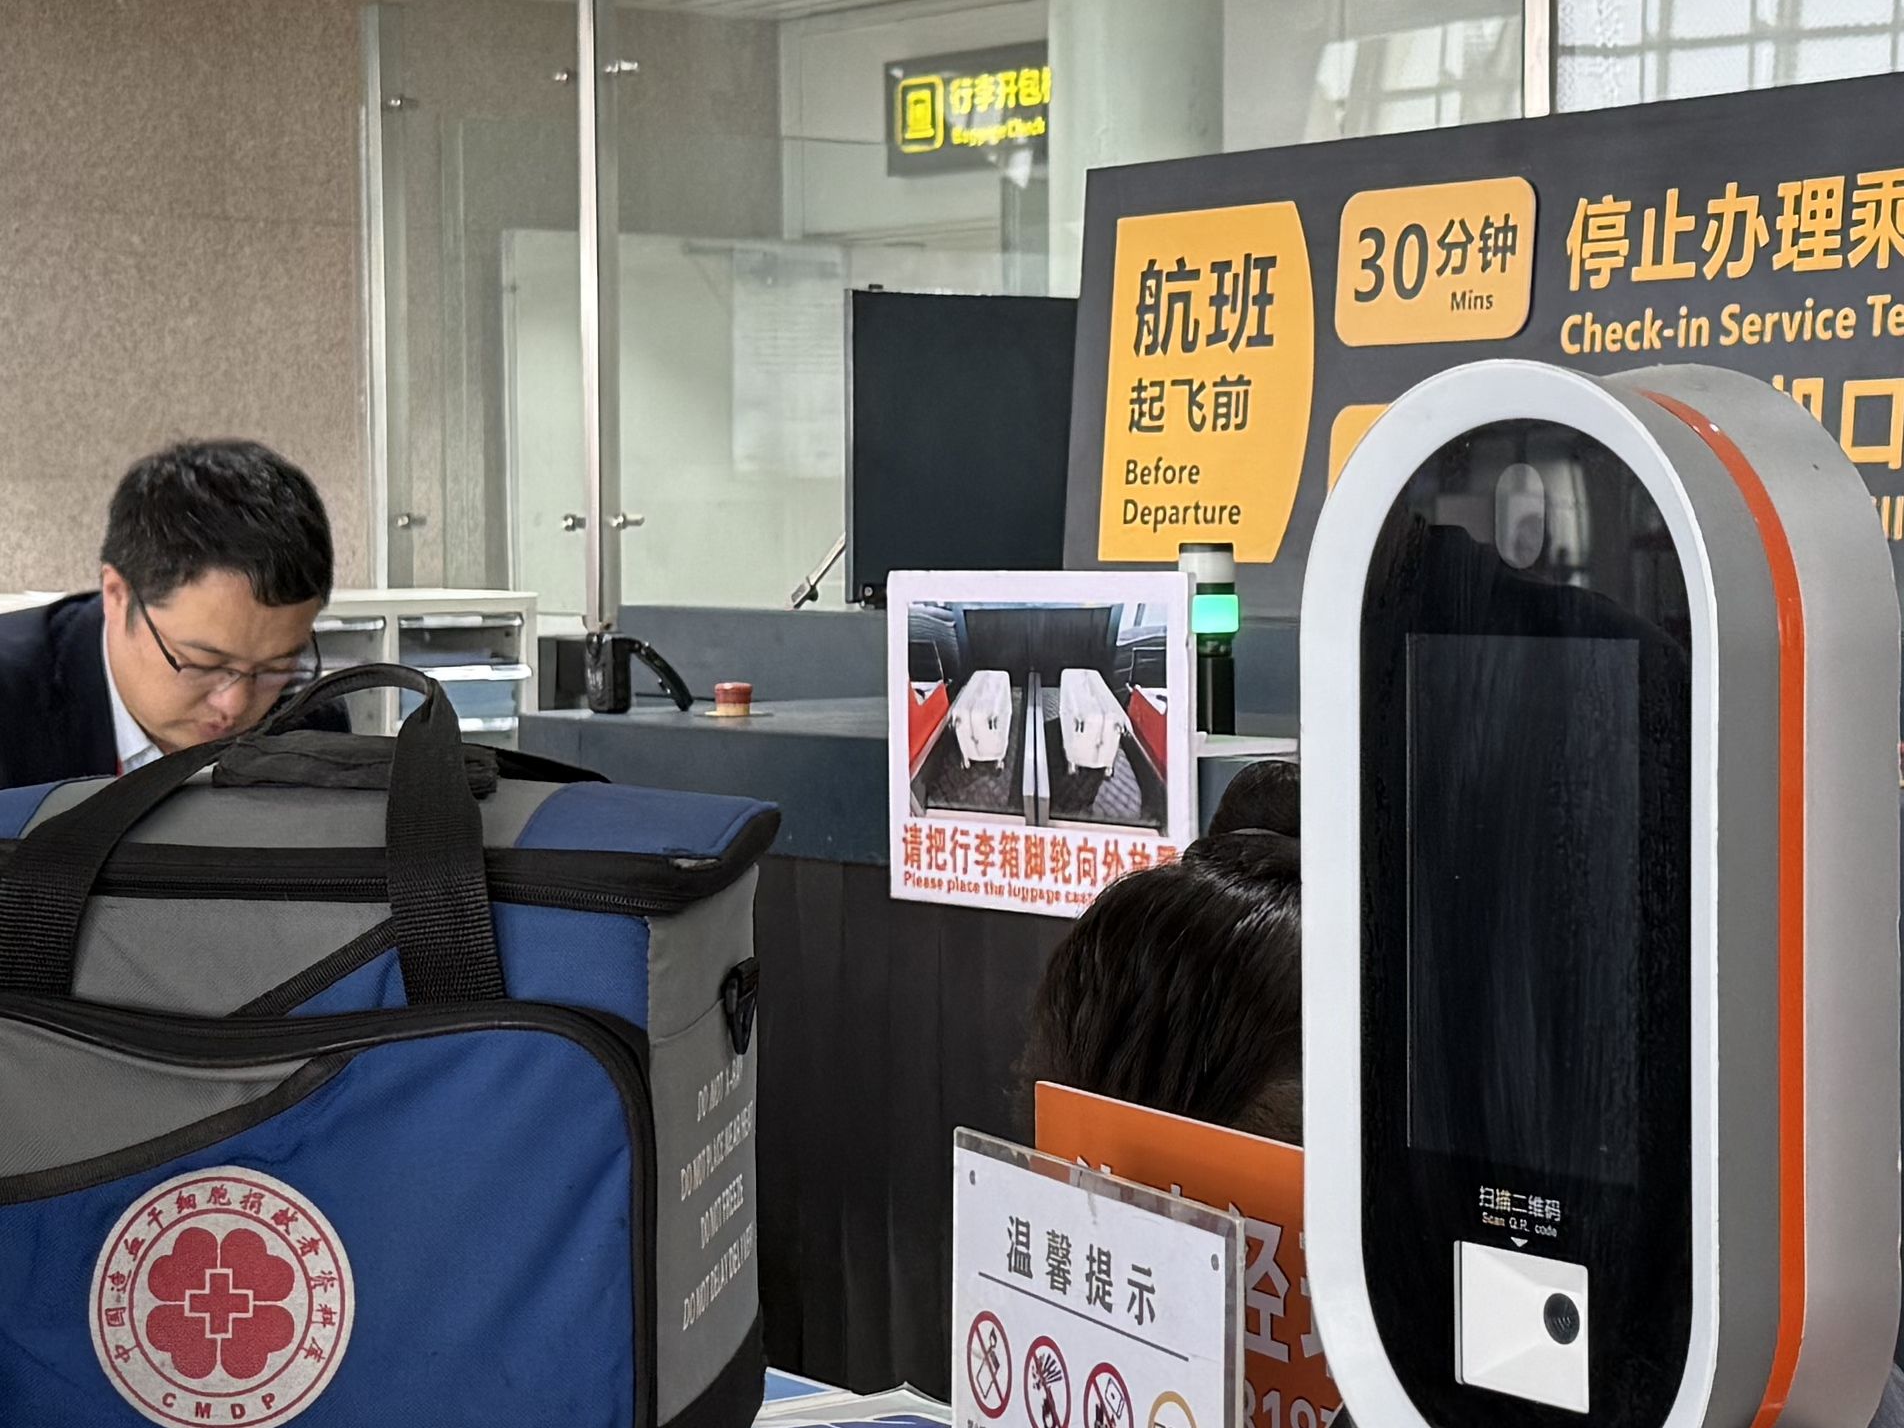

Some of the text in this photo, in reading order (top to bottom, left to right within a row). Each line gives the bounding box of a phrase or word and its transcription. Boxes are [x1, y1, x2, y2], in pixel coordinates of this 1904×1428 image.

[1354, 213, 1518, 303] 30分钟
[1133, 253, 1277, 357] 航班
[1450, 289, 1494, 313] Mins
[1560, 306, 1710, 354] Check-in
[1720, 297, 1857, 347] Service
[1128, 375, 1252, 434] 起飞前
[1125, 457, 1201, 485] Before
[1123, 499, 1241, 533] Departure
[904, 874, 944, 890] Please
[947, 878, 981, 894] place
[680, 1164, 692, 1202] DO
[1479, 1185, 1561, 1221] 扫描二维码
[700, 1211, 710, 1249] DO
[1006, 1214, 1156, 1327] 温馨提示
[682, 1292, 695, 1331] DO
[161, 1392, 276, 1420] CMDP
